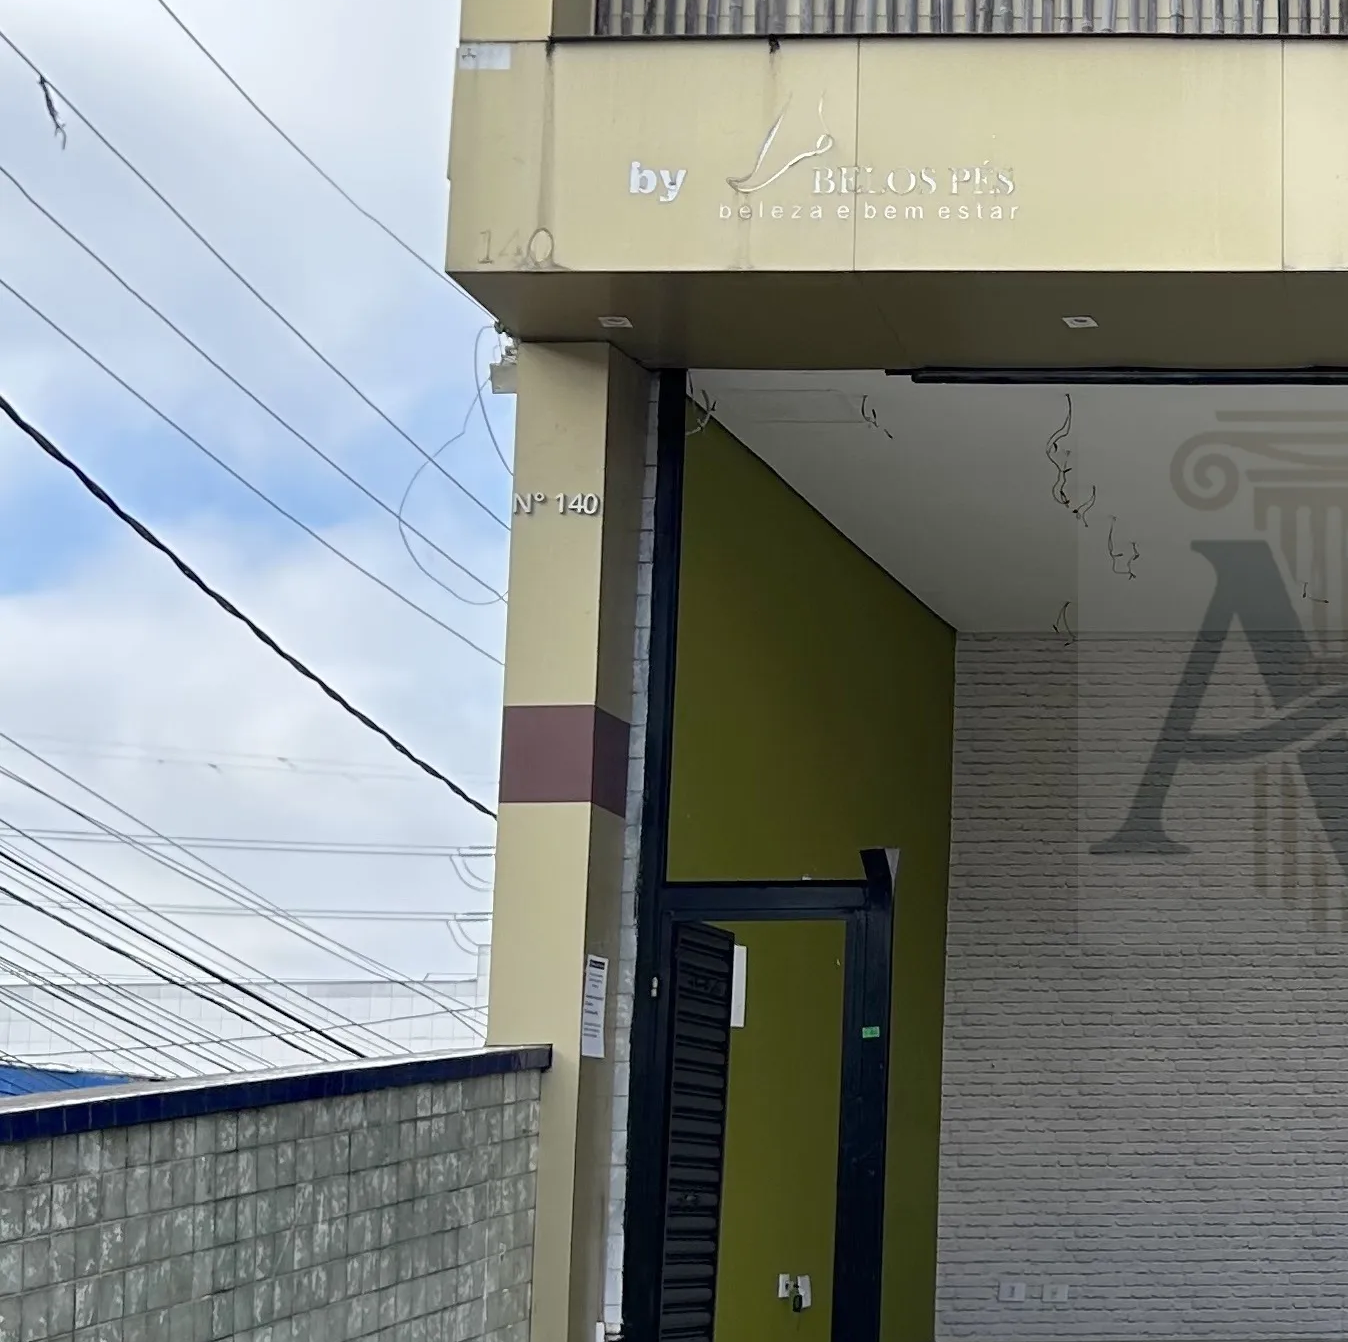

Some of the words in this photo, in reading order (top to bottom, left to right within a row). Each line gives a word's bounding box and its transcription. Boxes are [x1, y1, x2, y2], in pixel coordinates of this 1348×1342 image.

[628, 160, 687, 202] by
[811, 165, 938, 196] BELOS
[949, 159, 1015, 195] PÉS
[718, 201, 823, 220] beleza
[836, 205, 850, 220] e
[863, 201, 925, 220] bem
[937, 203, 1021, 220] estar
[555, 492, 600, 515] 140
